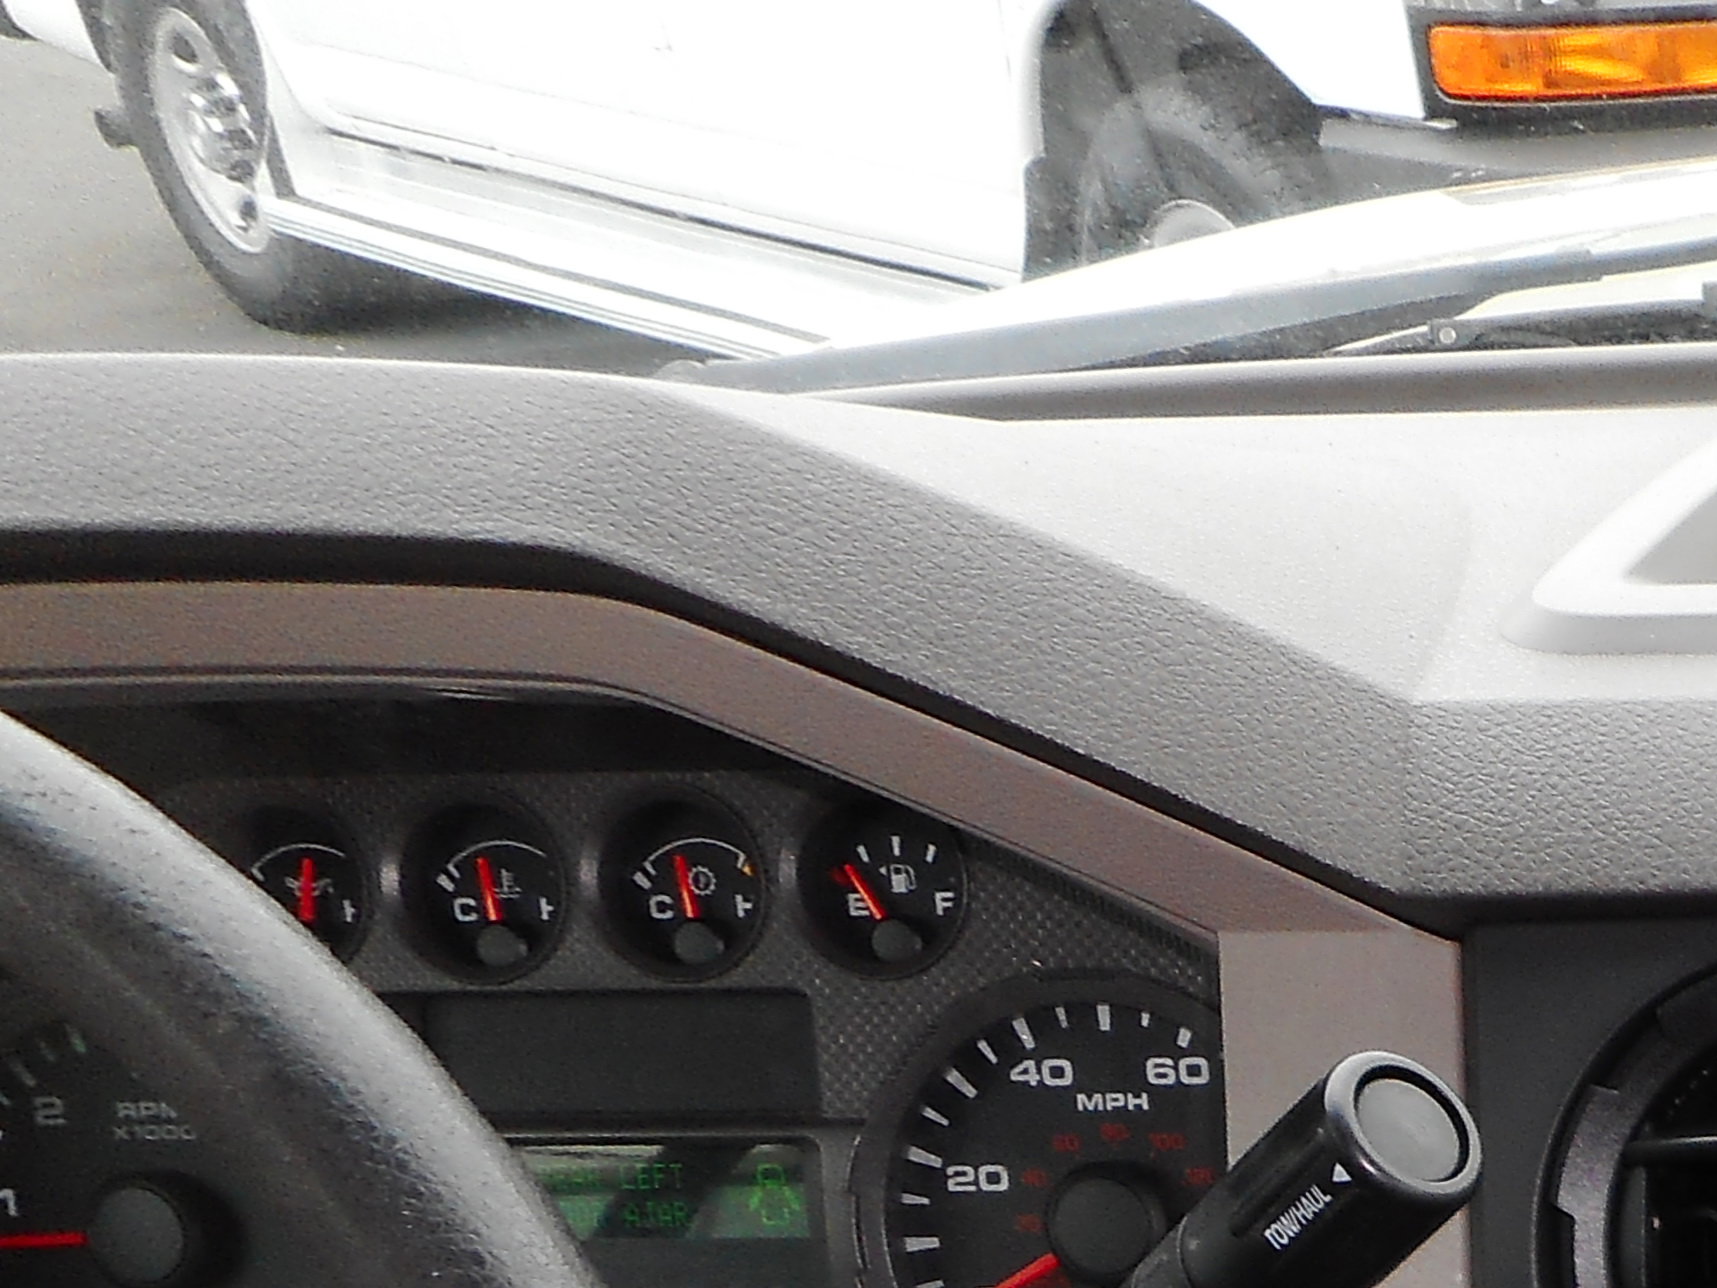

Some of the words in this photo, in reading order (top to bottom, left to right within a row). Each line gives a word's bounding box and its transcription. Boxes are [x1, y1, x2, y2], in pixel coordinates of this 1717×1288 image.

[453, 898, 478, 921] C
[649, 895, 675, 919] C
[848, 893, 870, 917] E
[934, 892, 955, 915] F
[1009, 1058, 1073, 1086] 40
[1145, 1056, 1210, 1085] 60
[34, 1096, 66, 1126] 2
[1076, 1092, 1149, 1111] MPH
[620, 1163, 683, 1190] LEFT
[946, 1164, 1009, 1192] 20
